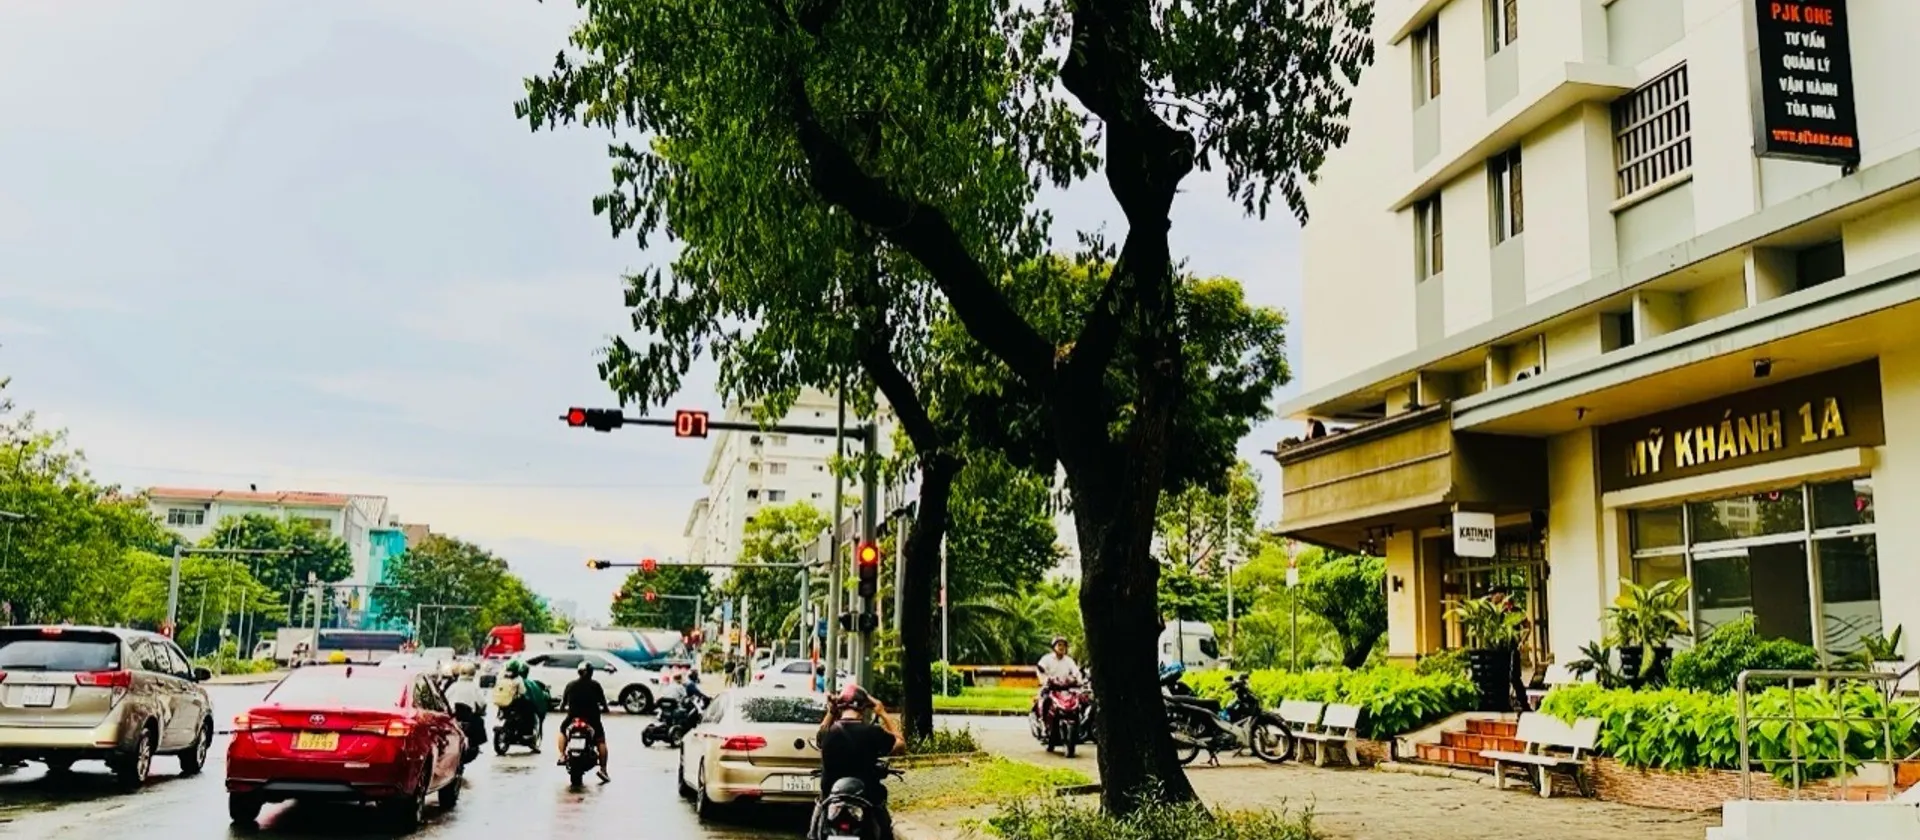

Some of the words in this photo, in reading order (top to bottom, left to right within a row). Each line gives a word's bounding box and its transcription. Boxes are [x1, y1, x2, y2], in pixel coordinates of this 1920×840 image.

[1771, 2, 1800, 22] PJK
[1804, 6, 1833, 26] ONE
[1783, 31, 1800, 46] TƯ
[1817, 57, 1831, 73] LÝ
[678, 412, 706, 435] 07
[1625, 427, 1664, 478] MỸ
[1674, 409, 1783, 468] KHÁNH
[1798, 397, 1845, 444] 1A
[1460, 526, 1493, 540] KATINAT
